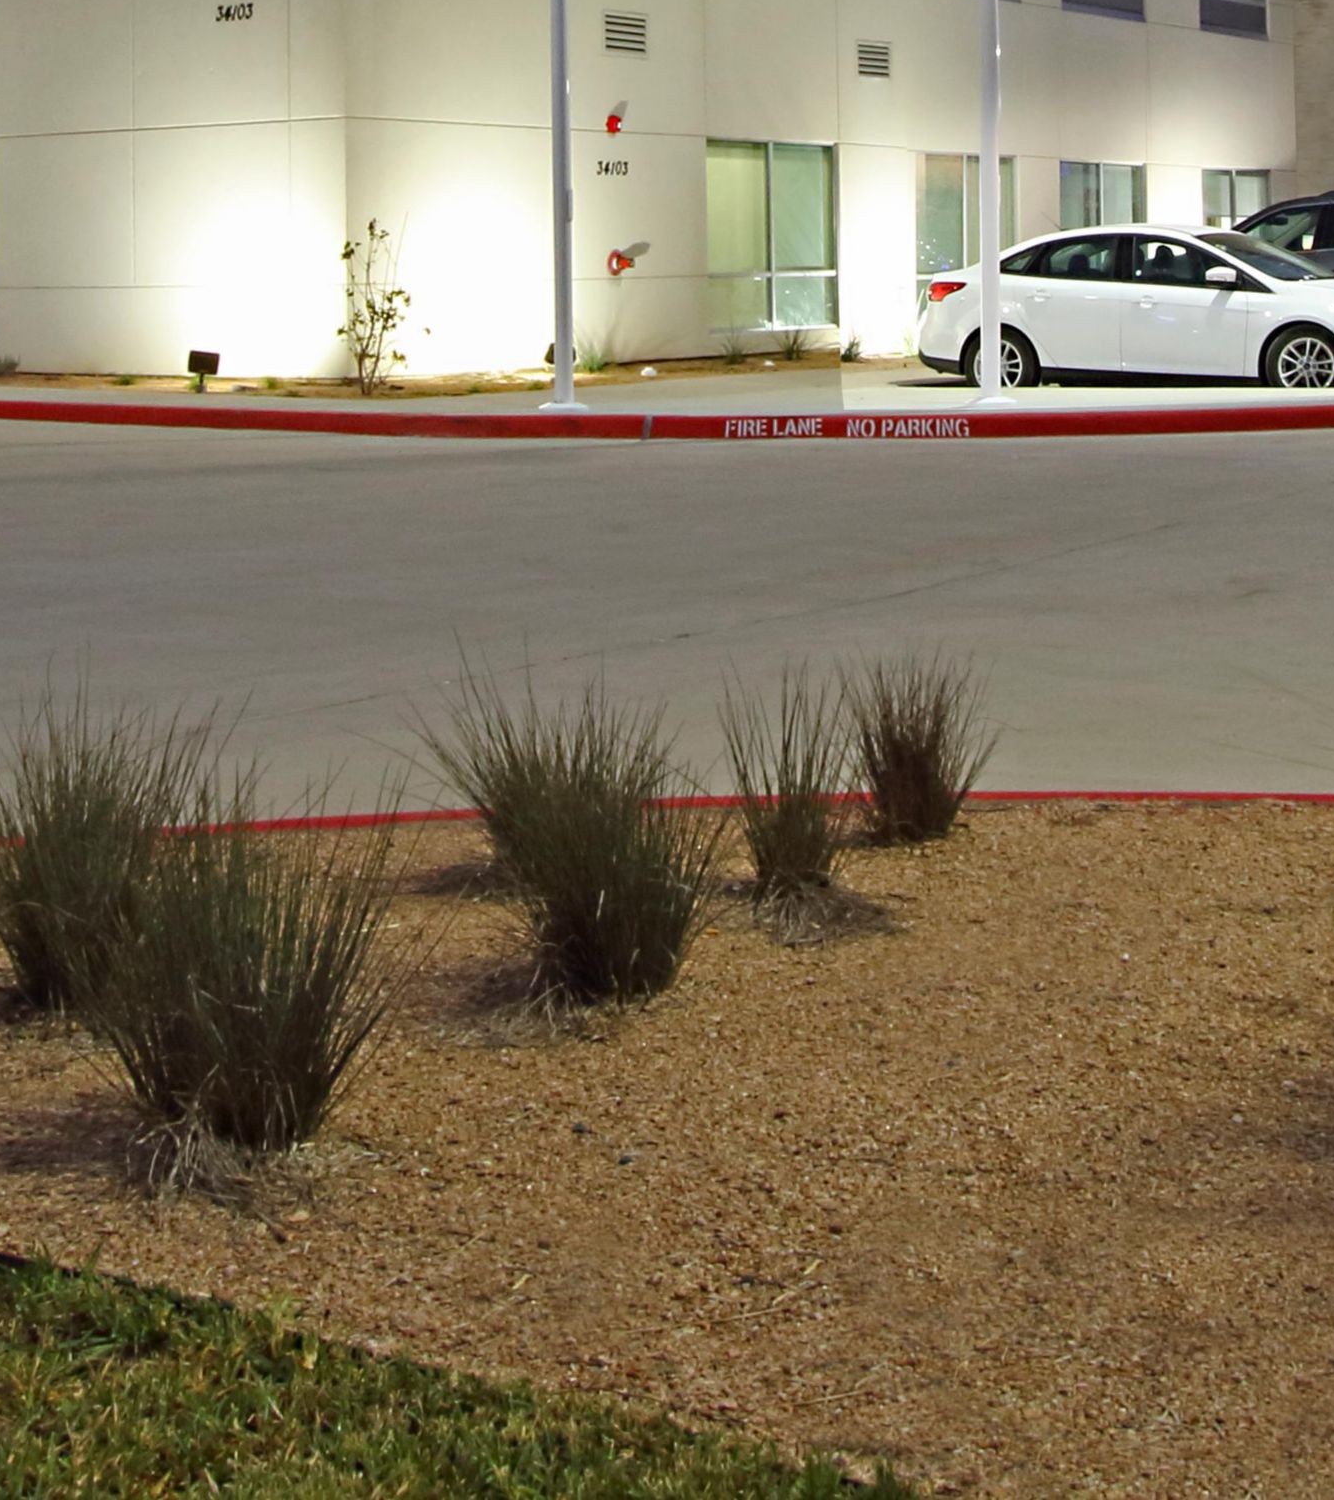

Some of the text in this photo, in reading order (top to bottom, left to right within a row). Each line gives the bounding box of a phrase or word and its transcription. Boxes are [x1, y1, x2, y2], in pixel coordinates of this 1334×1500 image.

[215, 2, 254, 22] 34103
[596, 159, 629, 176] 34103
[724, 417, 970, 438] FIRE LANE NO PARKING
